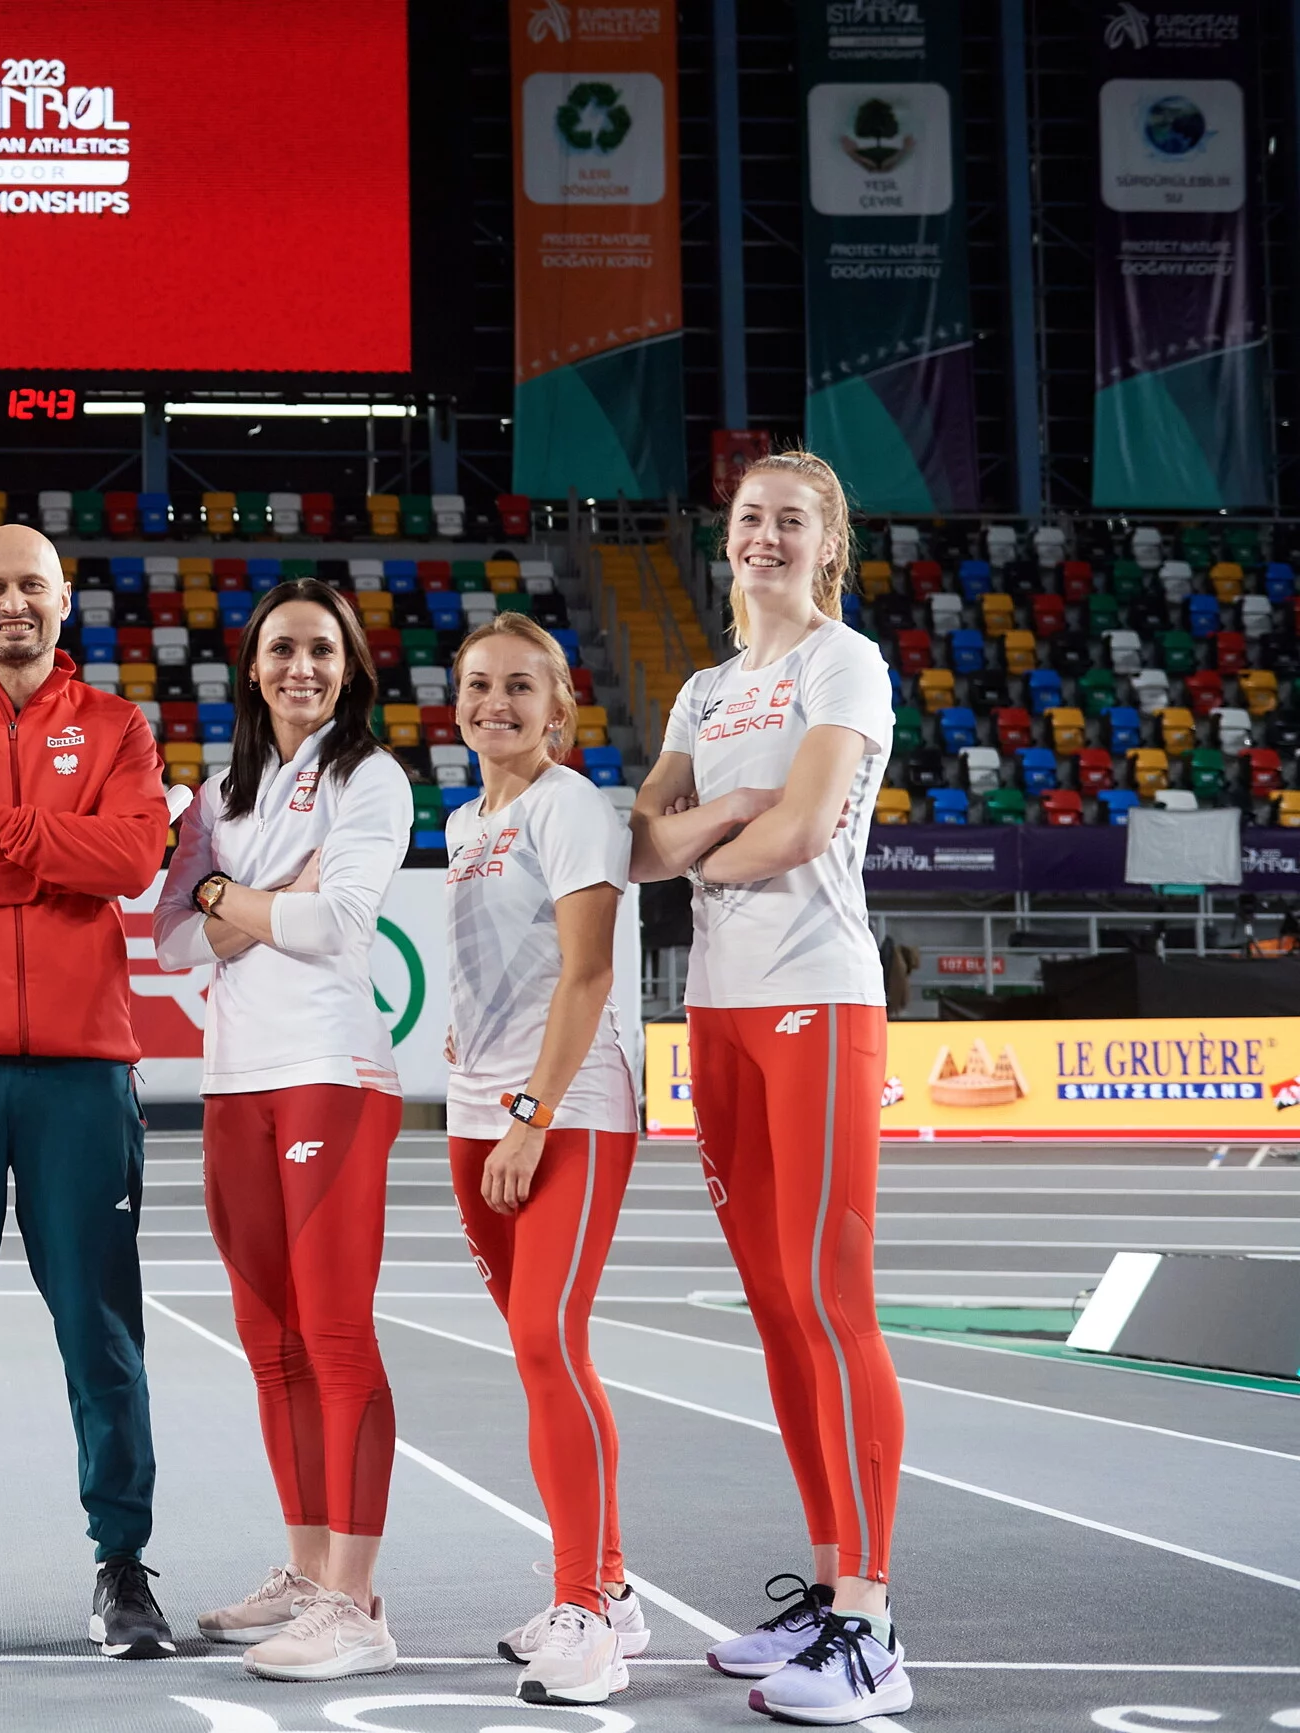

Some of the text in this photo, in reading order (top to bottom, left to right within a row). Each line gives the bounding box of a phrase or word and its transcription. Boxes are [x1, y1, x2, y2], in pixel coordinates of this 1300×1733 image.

[577, 8, 660, 20] EUROPEAN
[1154, 14, 1240, 27] EUROPEAN
[577, 21, 660, 34] ATHLETICS
[1154, 27, 1240, 40] ATHLETICS
[1, 59, 66, 87] 2023
[28, 138, 130, 154] ATHLETICS
[541, 233, 651, 246] PROTECT NATURE
[830, 243, 889, 257] PROTECT
[605, 254, 653, 268] KORU
[49, 736, 82, 747] ORLEN
[299, 772, 316, 781] ORL
[446, 861, 503, 885] OLSKA
[966, 959, 1003, 973] BLK
[775, 1009, 818, 1034] 4F
[1057, 1032, 1265, 1077] LE GRUYÈRE
[1064, 1083, 1256, 1099] SWITZERLAND
[285, 1141, 324, 1163] 4F
